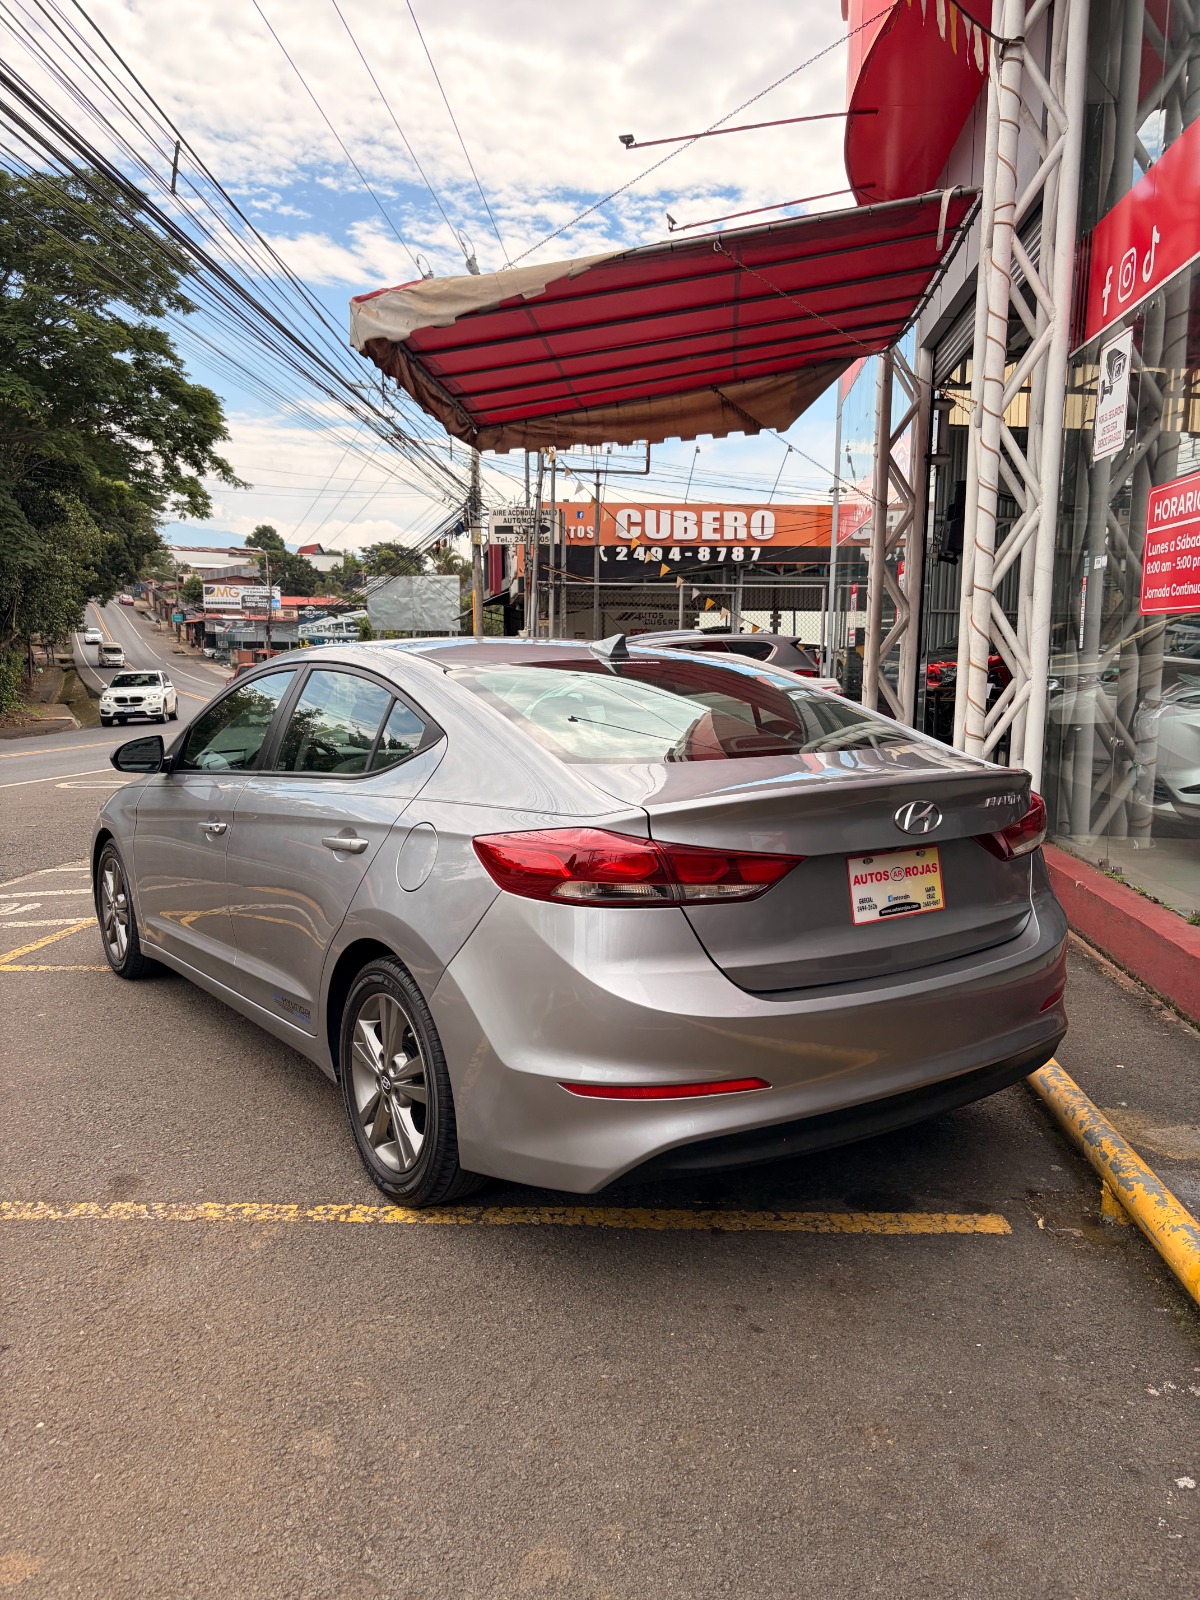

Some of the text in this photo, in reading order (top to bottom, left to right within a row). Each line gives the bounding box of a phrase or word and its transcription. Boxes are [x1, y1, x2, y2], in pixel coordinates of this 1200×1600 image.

[492, 509, 507, 517] AIRE
[615, 508, 775, 540] CUBERO
[616, 546, 761, 561] 2494-8787
[1148, 542, 1169, 556] Lunes
[1170, 541, 1175, 552] a
[1146, 561, 1161, 575] 8:00
[1161, 562, 1172, 572] am
[1176, 555, 1192, 570] 5:00
[1144, 584, 1170, 599] Jornada
[853, 870, 889, 886] AUTOS
[904, 863, 938, 878] ROJAS
